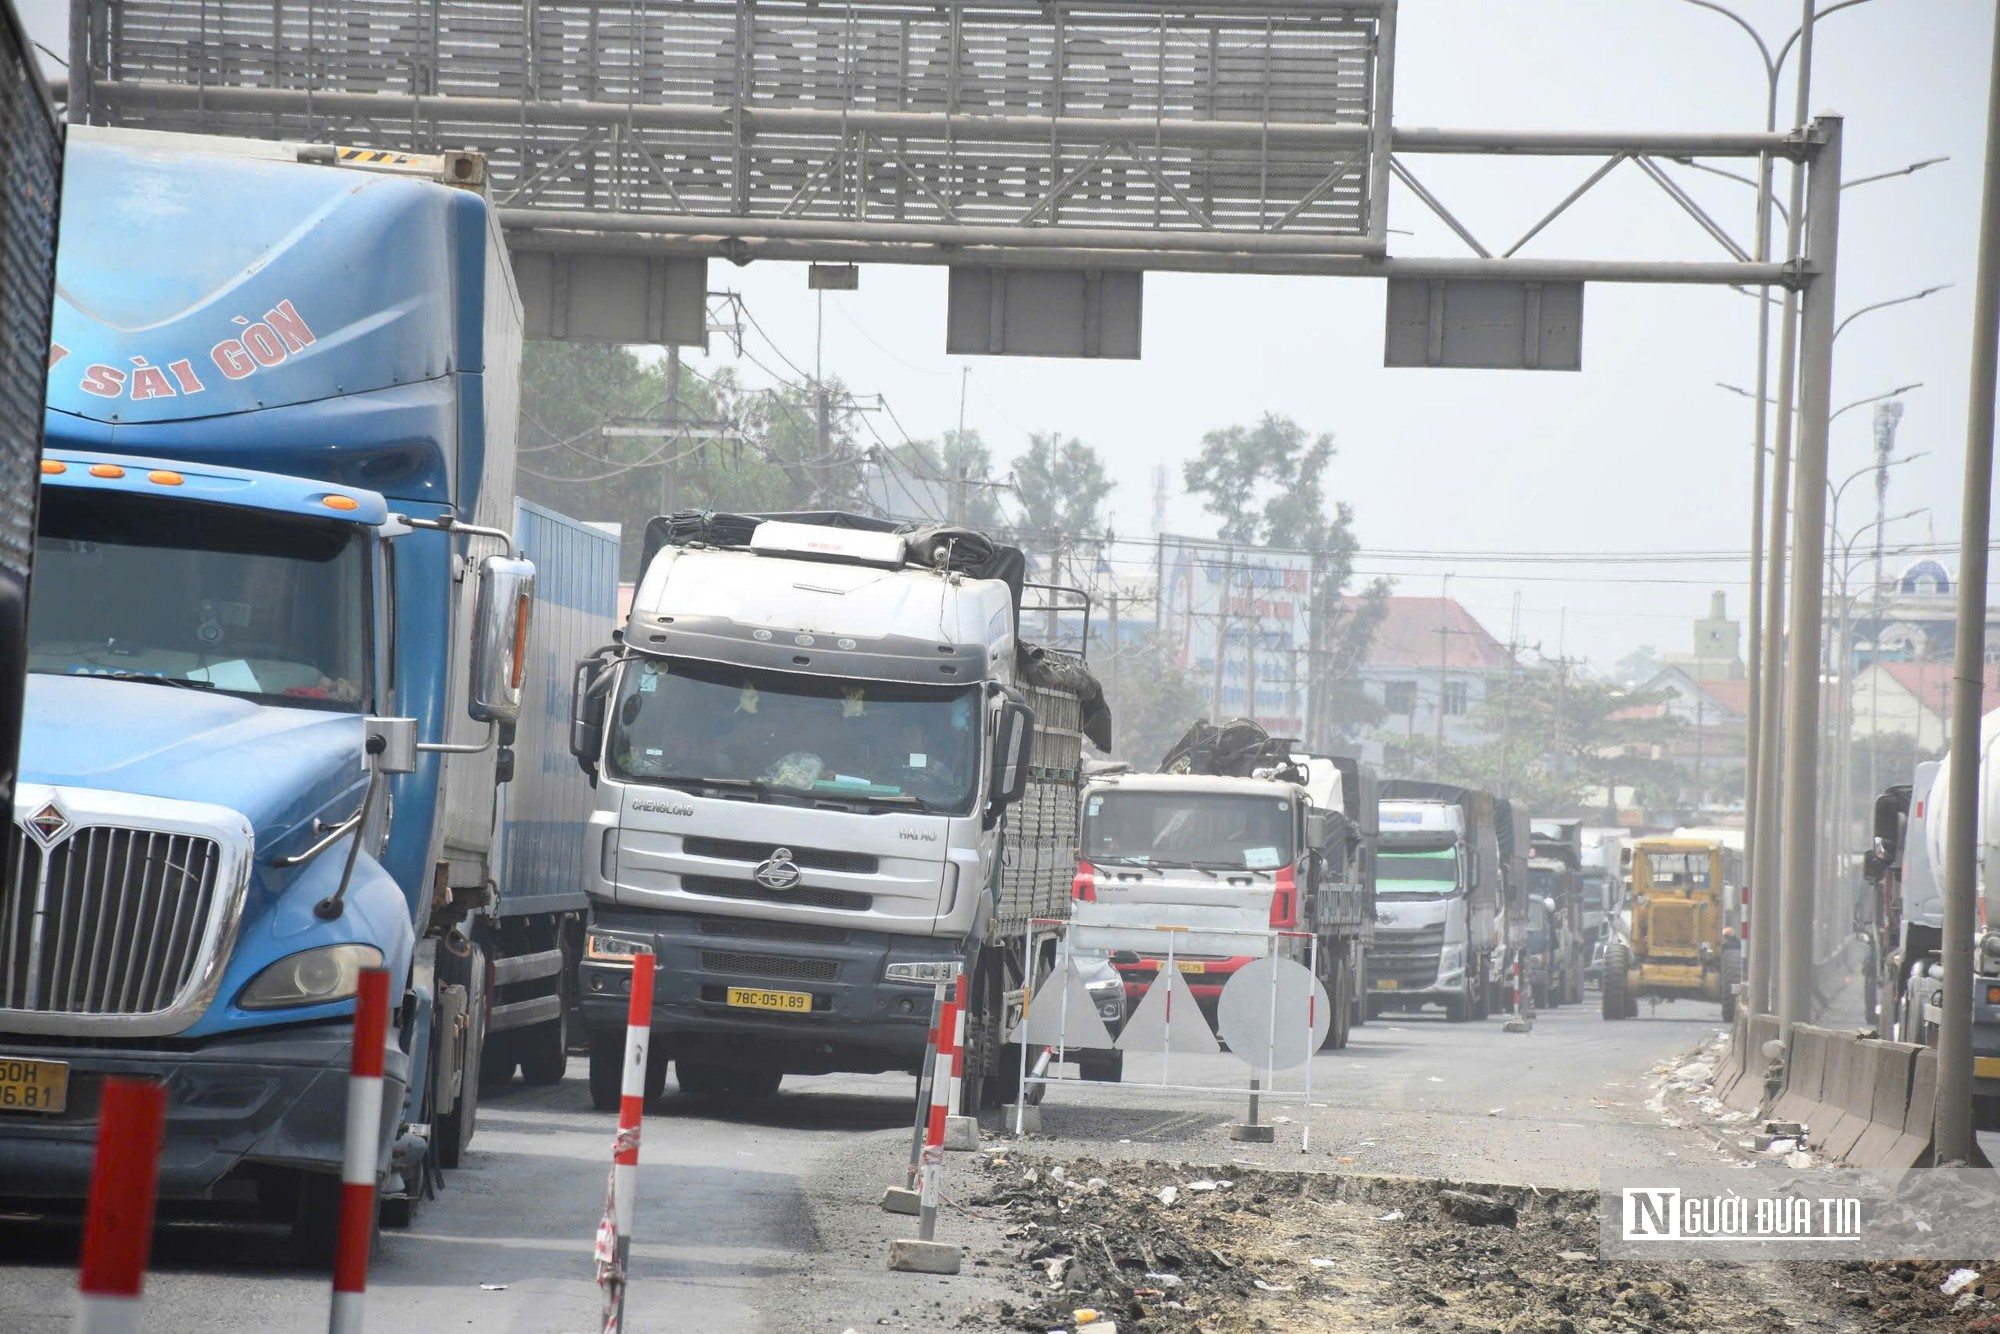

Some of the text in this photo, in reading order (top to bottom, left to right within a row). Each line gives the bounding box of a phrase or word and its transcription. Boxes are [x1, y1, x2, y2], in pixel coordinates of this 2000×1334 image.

[79, 356, 205, 401] SÀI
[211, 299, 317, 380] GÒN
[632, 799, 694, 817] CHENGLONG
